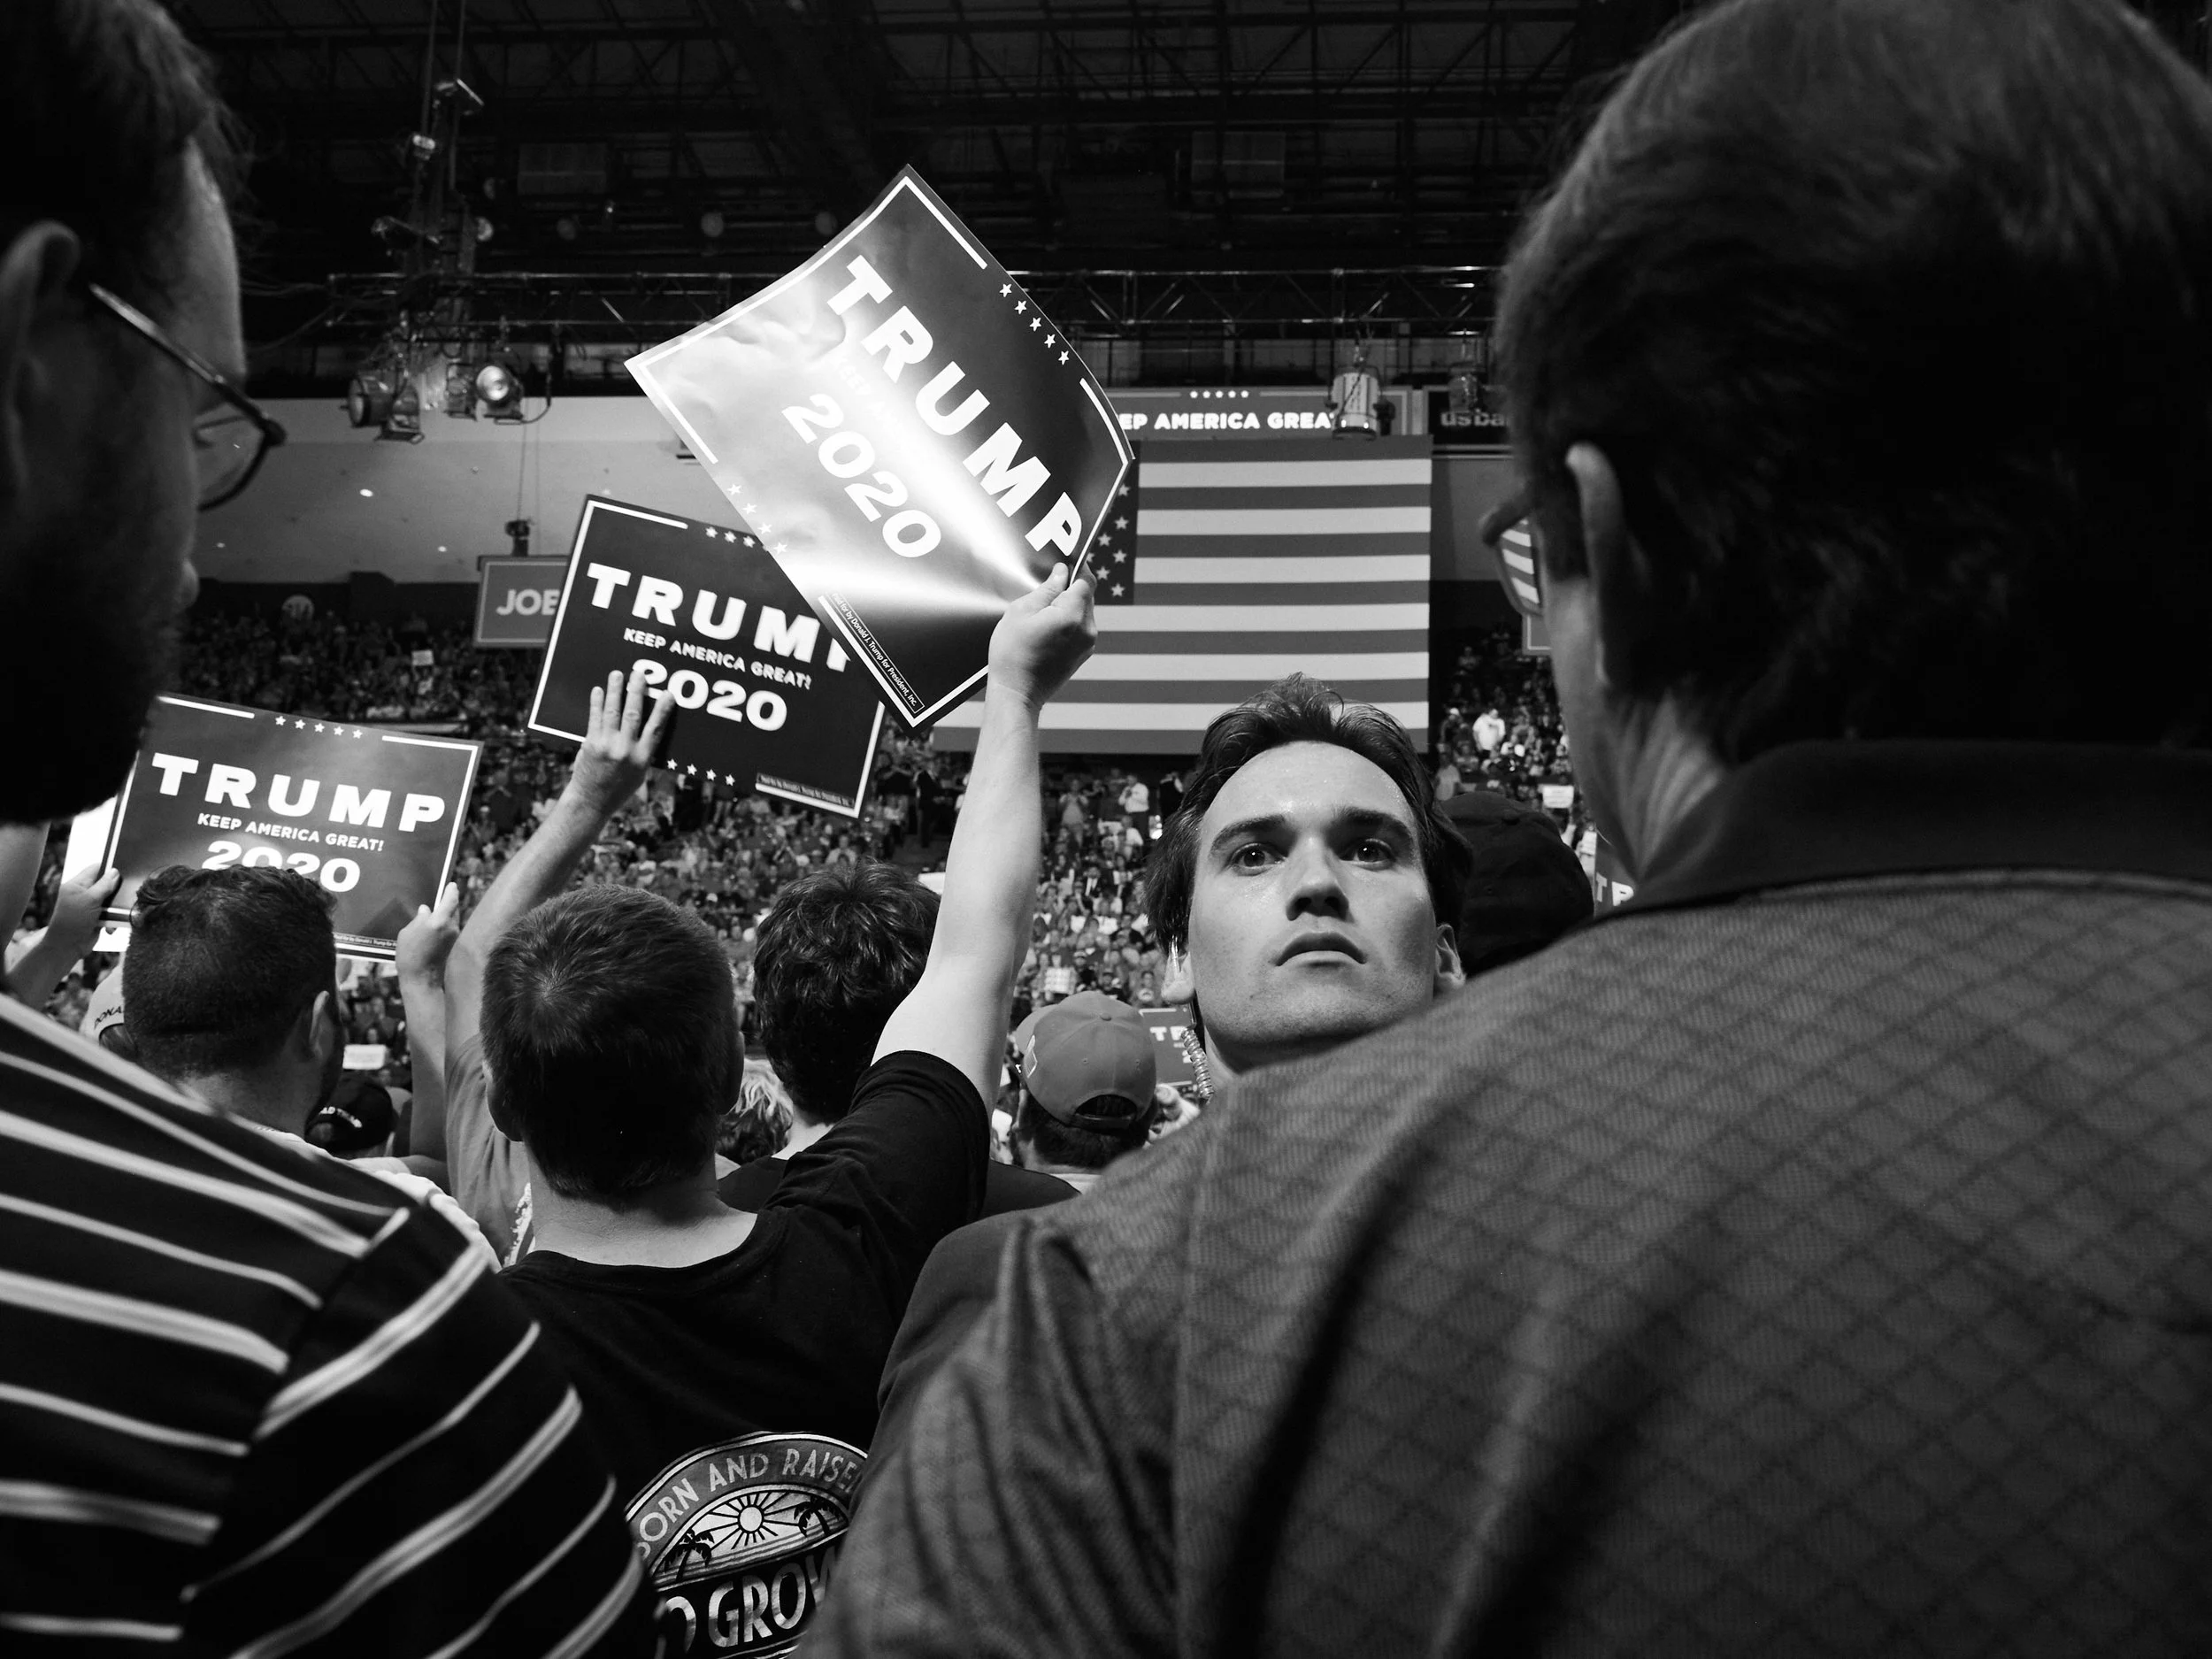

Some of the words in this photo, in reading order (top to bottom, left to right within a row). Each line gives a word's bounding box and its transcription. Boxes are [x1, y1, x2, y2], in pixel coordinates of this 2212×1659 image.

[827, 255, 1082, 557] TRUMP
[1118, 413, 1148, 430] EP
[1154, 412, 1260, 430] AMERICA
[1267, 412, 1335, 429] GREA
[781, 394, 941, 558] 2020
[495, 588, 561, 616] JOE
[623, 627, 666, 649] KEEP
[669, 640, 746, 672] AMERICA
[750, 661, 811, 690] GREAT!
[851, 618, 870, 639] Donald
[868, 640, 883, 661] Trump
[881, 658, 890, 669] for
[887, 666, 910, 697] President,
[907, 695, 918, 707] Inc.
[151, 752, 446, 832] TRUMP
[197, 813, 242, 831] KEEP
[245, 821, 320, 843] AMERICA
[325, 833, 385, 852] GREAT!
[94, 1005, 123, 1031] DONA
[708, 1452, 769, 1493] AND
[782, 1448, 864, 1494] RAISE
